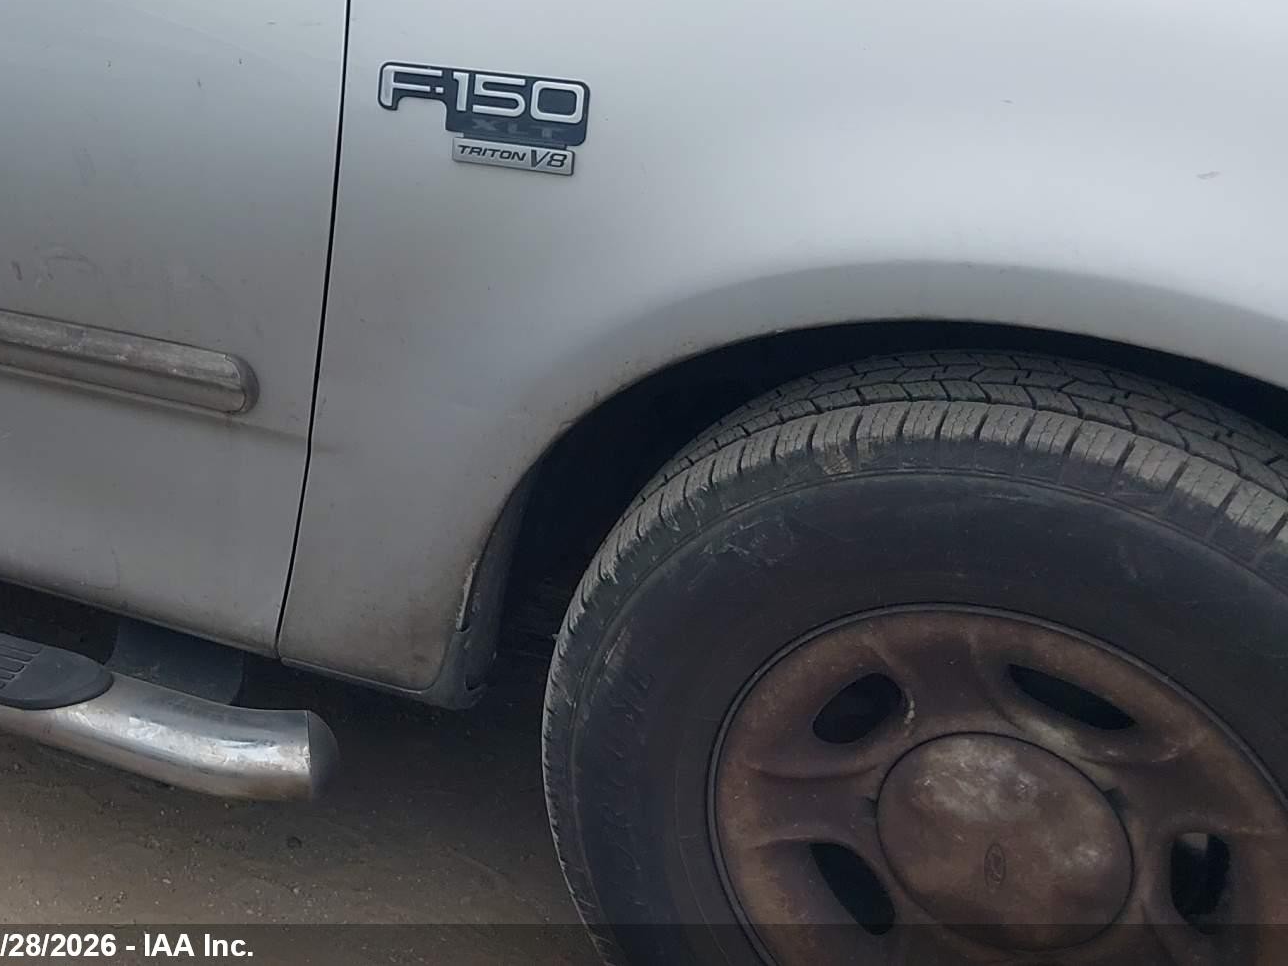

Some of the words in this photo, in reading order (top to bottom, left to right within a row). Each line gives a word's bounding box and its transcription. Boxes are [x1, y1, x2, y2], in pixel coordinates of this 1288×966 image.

[471, 118, 564, 139] XLT
[457, 144, 527, 162] TRITON
[529, 148, 568, 169] V8
